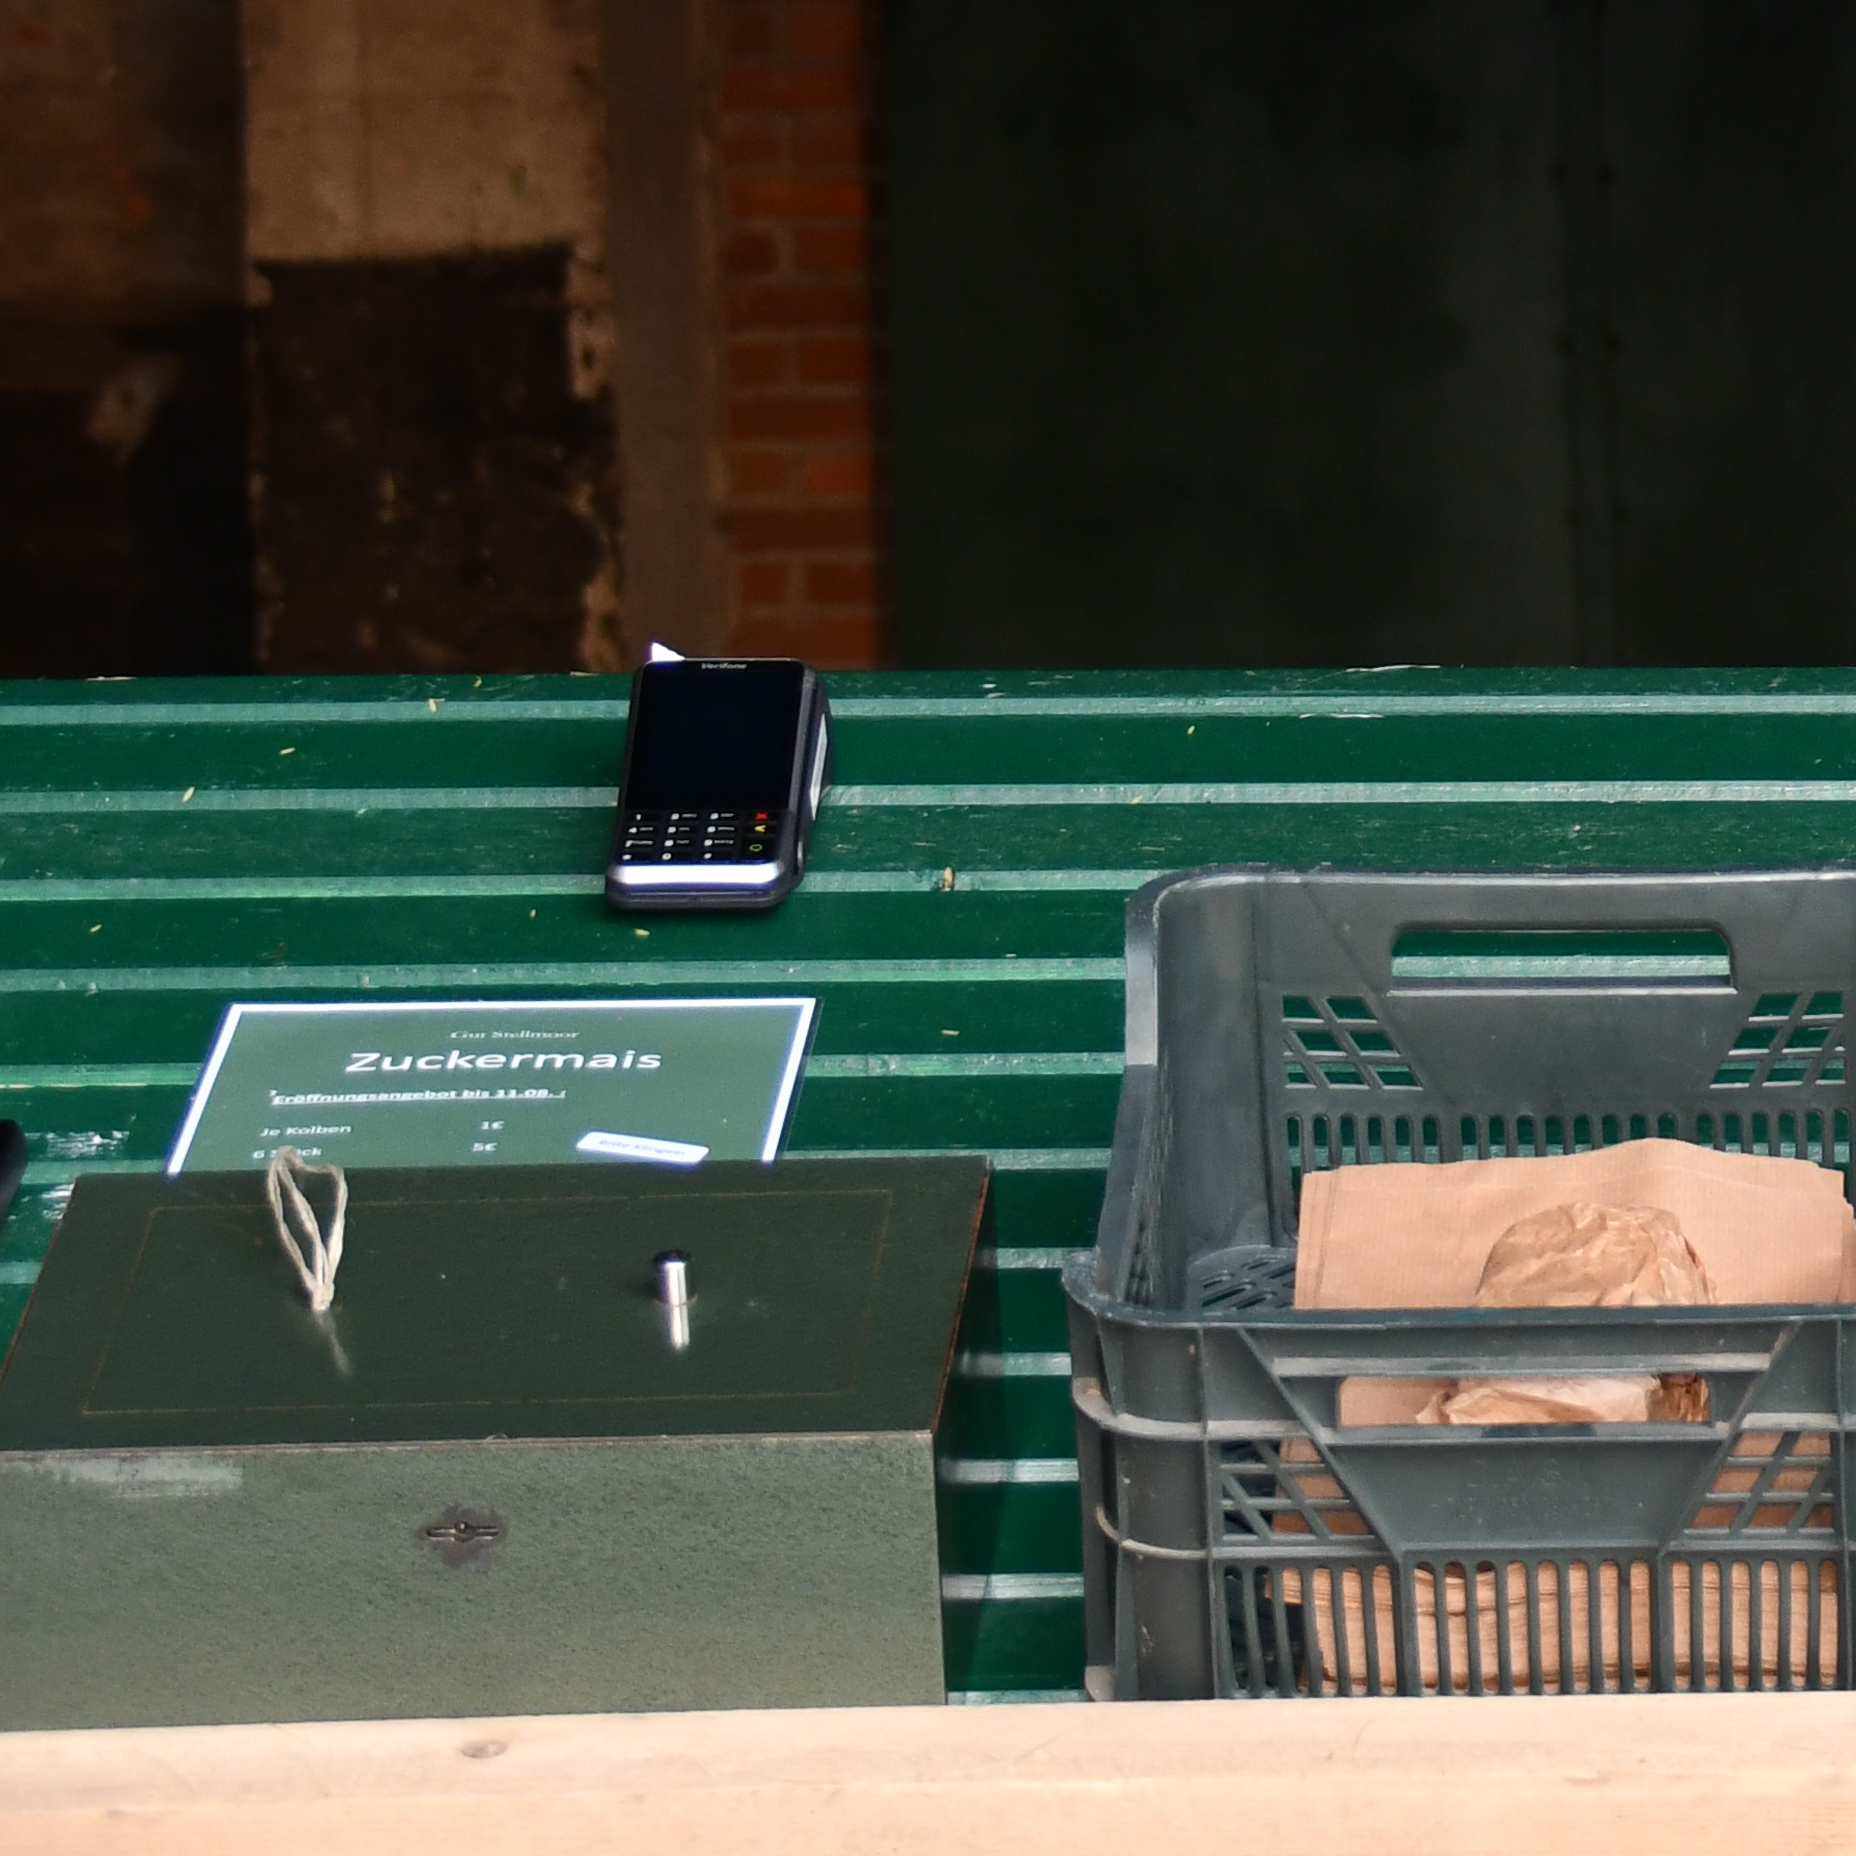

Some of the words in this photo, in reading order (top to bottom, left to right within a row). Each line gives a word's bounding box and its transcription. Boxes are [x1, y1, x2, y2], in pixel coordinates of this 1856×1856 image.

[344, 1049, 662, 1072] Zuckermais
[461, 1088, 490, 1102] bis
[259, 1126, 281, 1138] Je
[285, 1123, 352, 1136] Kolben
[480, 1120, 505, 1131] 1€
[472, 1142, 498, 1152] 5€
[252, 1149, 266, 1159] 6
